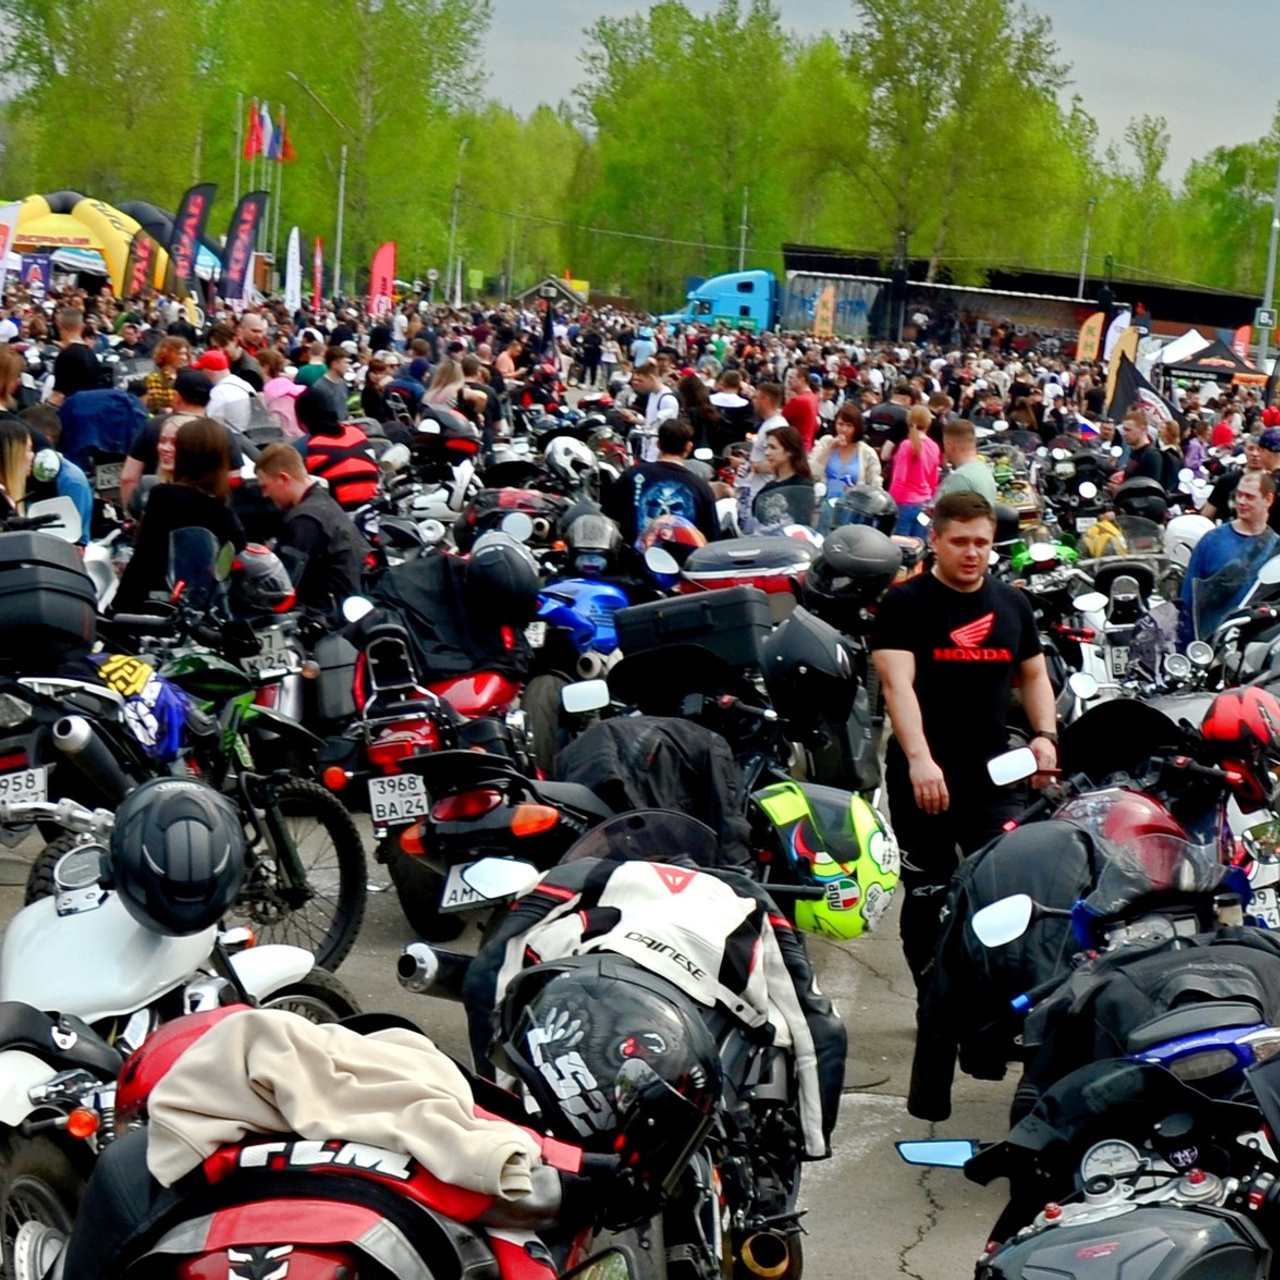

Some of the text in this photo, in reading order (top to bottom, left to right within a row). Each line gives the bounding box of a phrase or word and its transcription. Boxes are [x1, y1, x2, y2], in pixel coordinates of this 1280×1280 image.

[932, 648, 1013, 662] HONDA
[376, 776, 417, 794] 3968
[376, 799, 425, 818] BA 24
[624, 931, 706, 980] DAINESE
